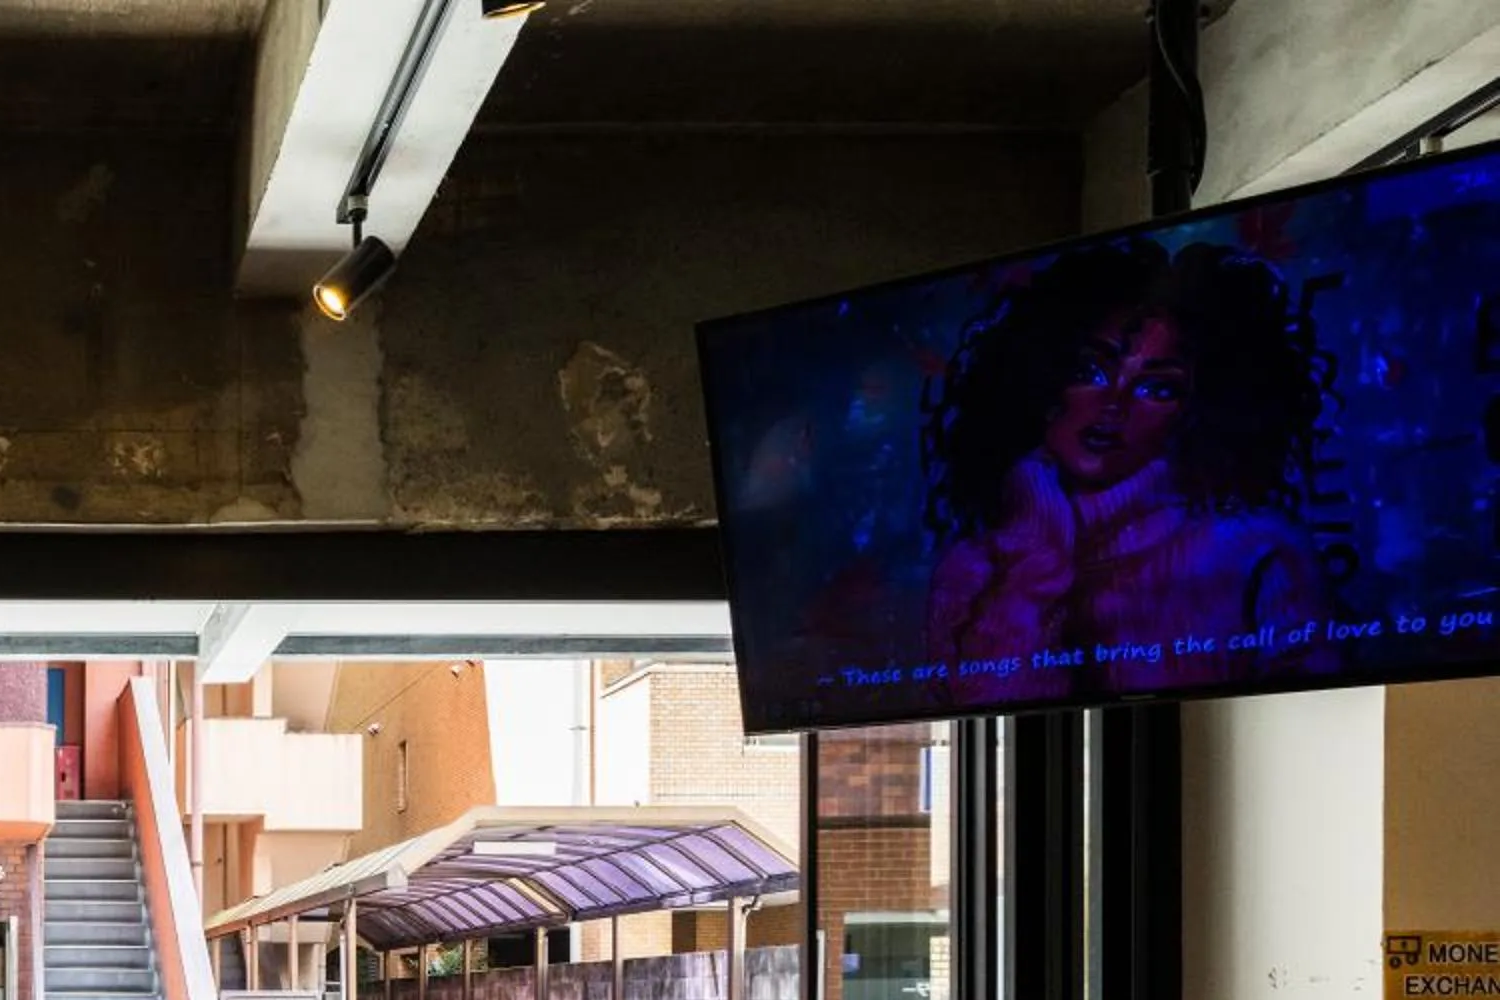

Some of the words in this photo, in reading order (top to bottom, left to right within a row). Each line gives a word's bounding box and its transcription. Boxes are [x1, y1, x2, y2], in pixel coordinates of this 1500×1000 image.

[912, 663, 947, 679] are
[958, 655, 1021, 677] songs
[1031, 648, 1084, 668] that
[1095, 642, 1161, 663] bring
[1174, 635, 1214, 655] the
[1228, 626, 1274, 649] call
[1287, 621, 1317, 644] of
[1327, 618, 1383, 641] love
[1396, 612, 1426, 633] to
[1439, 610, 1493, 635] you
[1428, 943, 1500, 963] MONE
